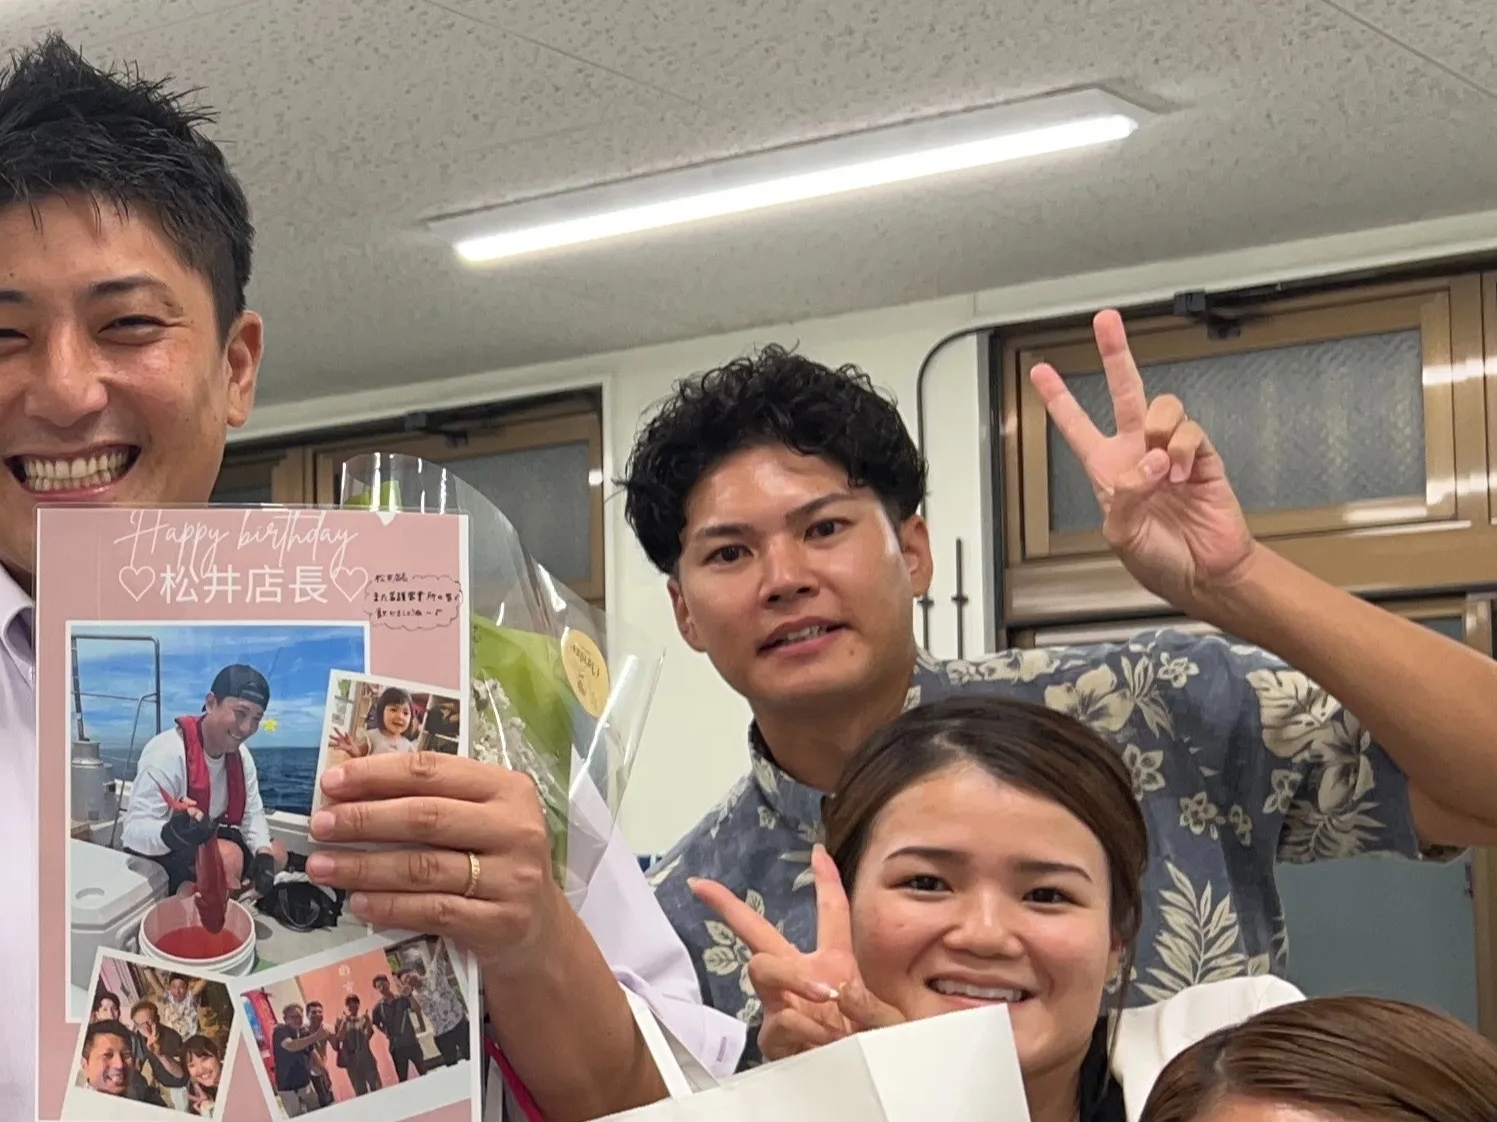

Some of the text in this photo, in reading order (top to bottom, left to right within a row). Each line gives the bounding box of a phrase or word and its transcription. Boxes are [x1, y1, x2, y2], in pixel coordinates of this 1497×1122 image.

[113, 510, 359, 578] Happy birthday
[160, 564, 328, 604] 松井店長
